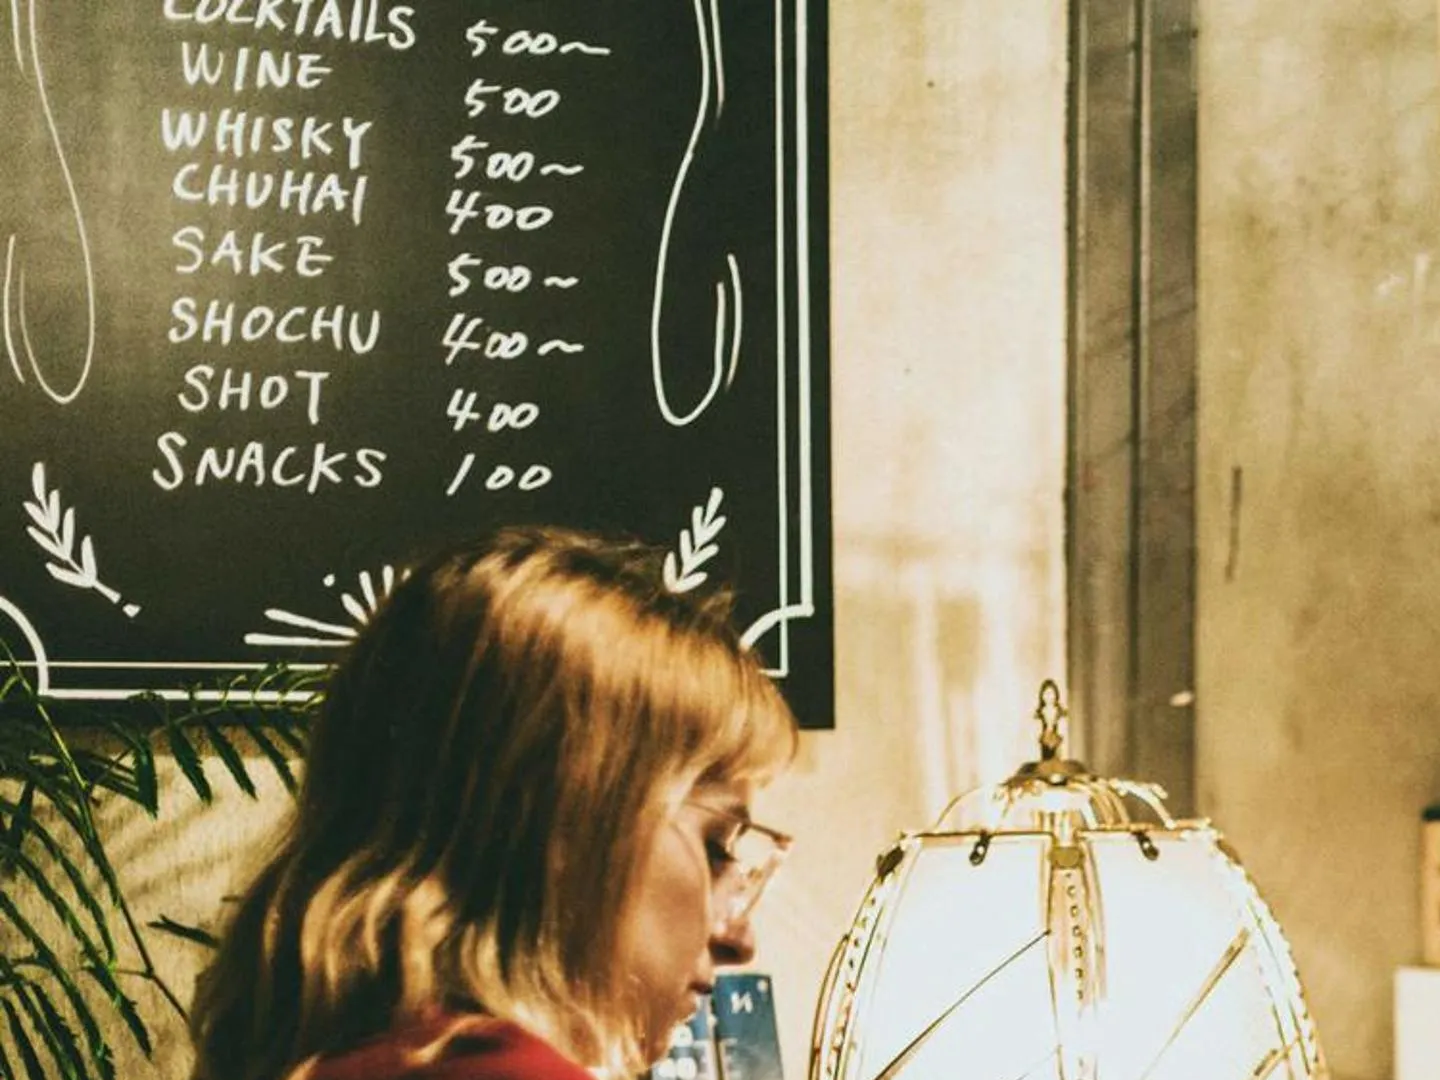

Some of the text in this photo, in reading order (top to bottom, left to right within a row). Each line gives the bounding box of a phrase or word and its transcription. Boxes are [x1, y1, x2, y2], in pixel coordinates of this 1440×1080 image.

[163, 0, 416, 51] COCKTAILS
[181, 41, 561, 119] WINE 500
[161, 108, 373, 170] WHISKY
[172, 163, 554, 236] CHUHAI 400
[171, 226, 334, 278] SAKE
[168, 297, 381, 355] SHOCHU
[177, 364, 540, 433] SHOT 400
[151, 431, 553, 497] SNACKS 100
